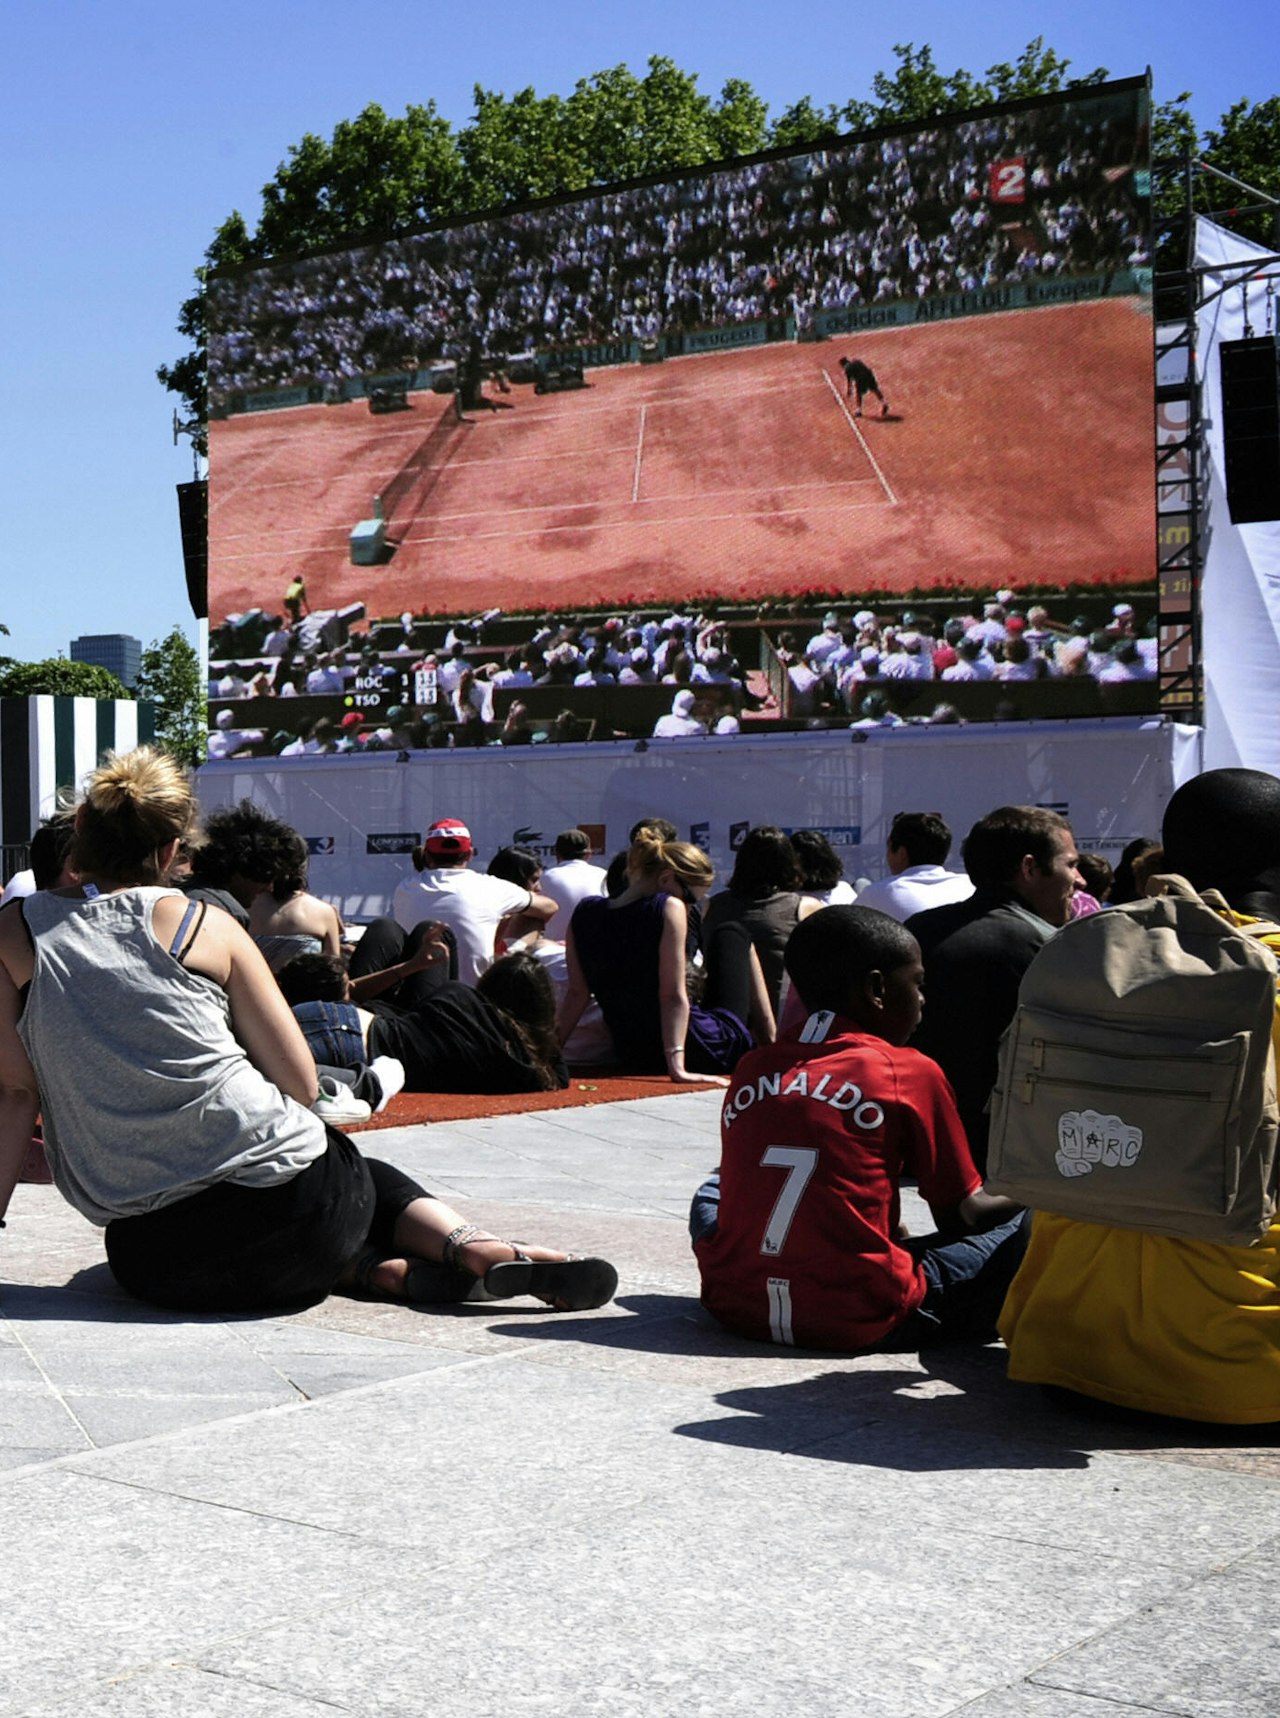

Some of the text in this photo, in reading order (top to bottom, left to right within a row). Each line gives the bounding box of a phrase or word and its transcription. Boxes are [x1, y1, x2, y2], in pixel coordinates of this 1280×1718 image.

[997, 165, 1025, 197] 2
[354, 693, 381, 706] TSO
[723, 1072, 885, 1130] RONALDO
[1062, 1128, 1139, 1160] MARC
[759, 1145, 819, 1257] 7
